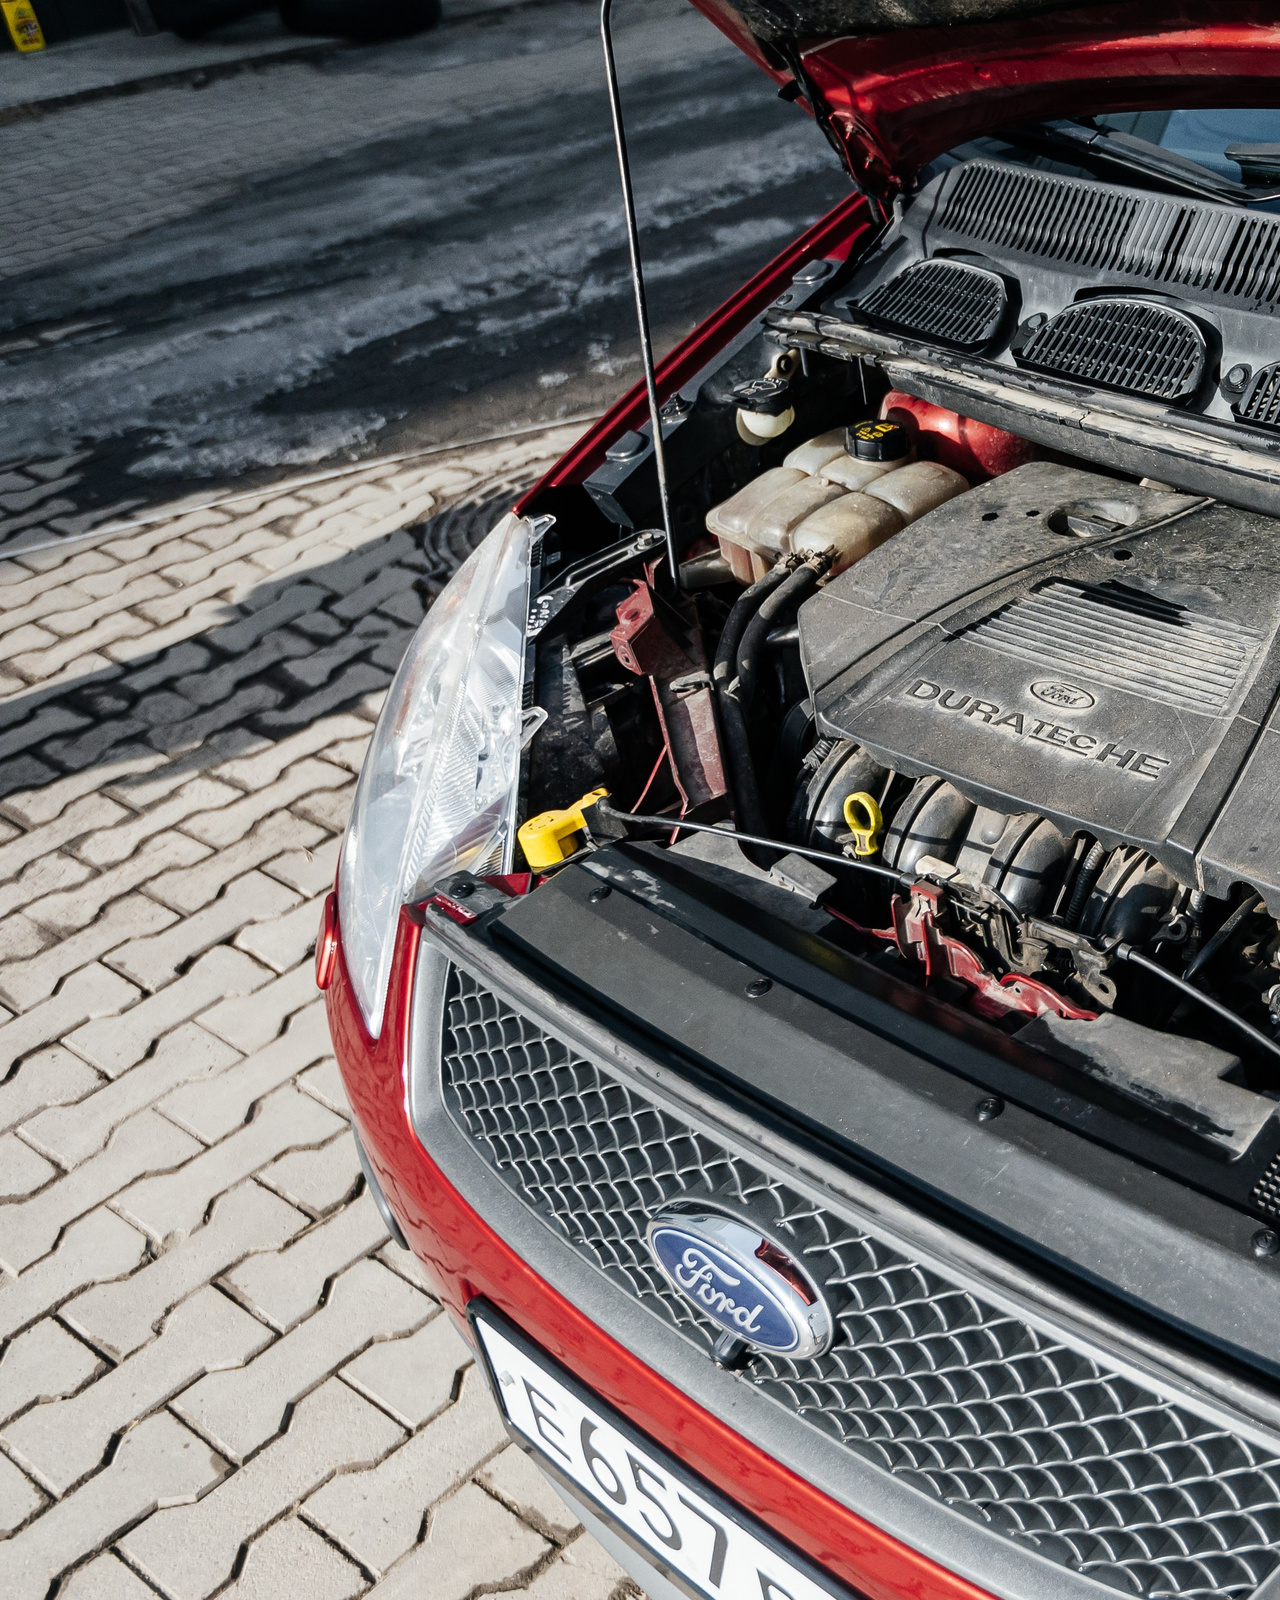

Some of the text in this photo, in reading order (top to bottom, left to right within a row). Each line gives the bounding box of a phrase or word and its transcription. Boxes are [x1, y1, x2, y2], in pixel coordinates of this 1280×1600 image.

[905, 679, 1170, 780] DURATEC HE
[1040, 683, 1082, 706] Ford
[673, 1247, 765, 1333] Ford
